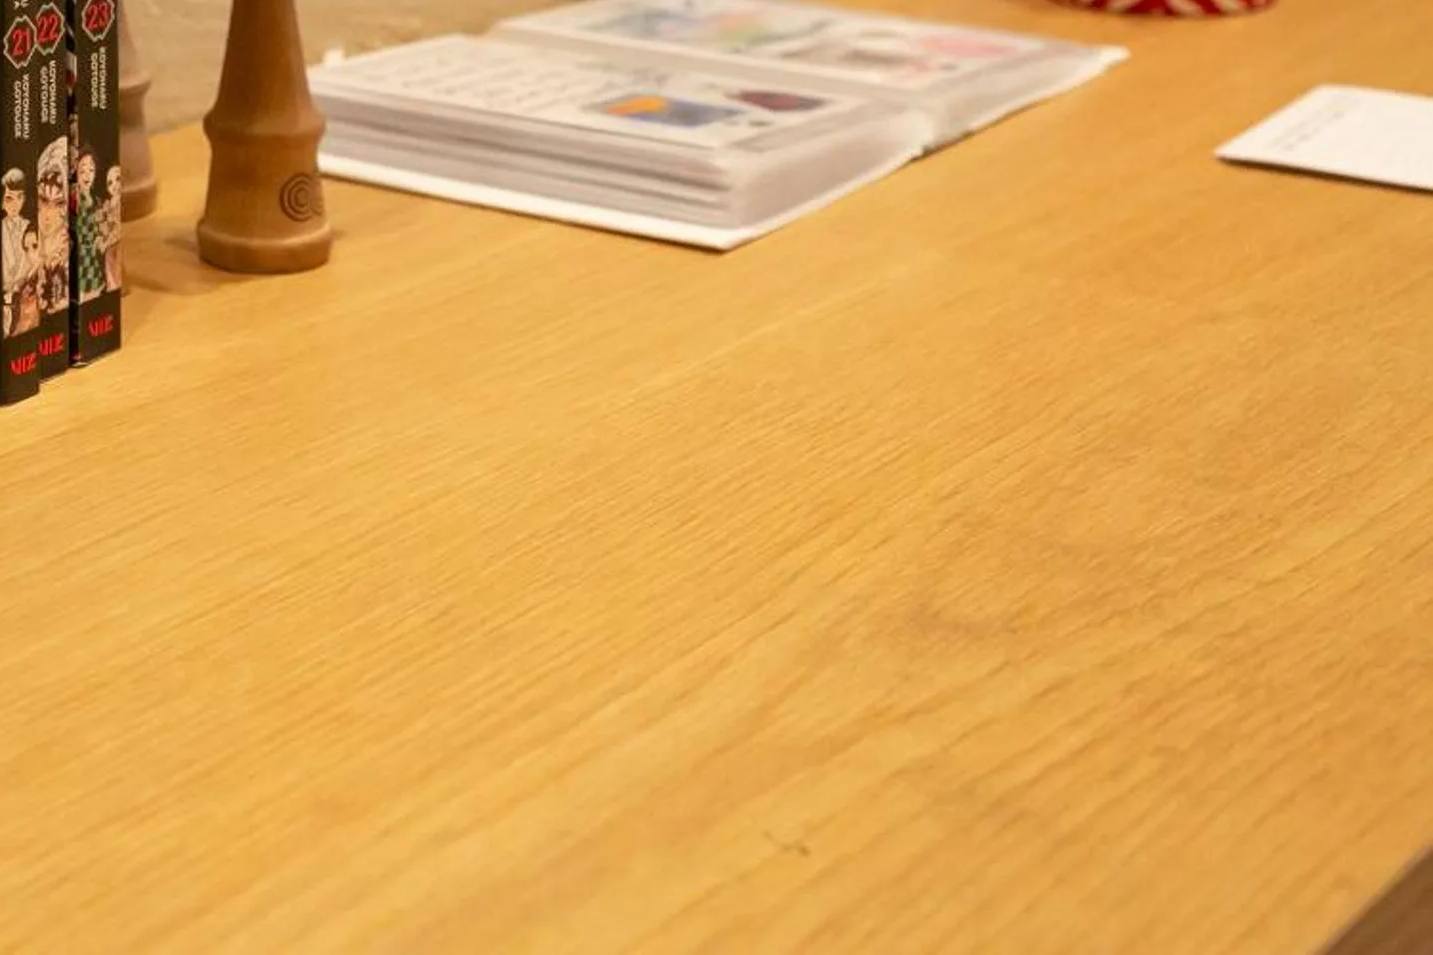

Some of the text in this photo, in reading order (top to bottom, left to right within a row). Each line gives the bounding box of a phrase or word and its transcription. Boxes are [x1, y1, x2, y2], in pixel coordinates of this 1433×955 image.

[37, 15, 59, 42] 22
[87, 1, 110, 31] 23
[12, 28, 31, 55] 21
[87, 315, 112, 337] VIZ
[38, 332, 65, 357] VIZ
[10, 352, 38, 376] VIZ
